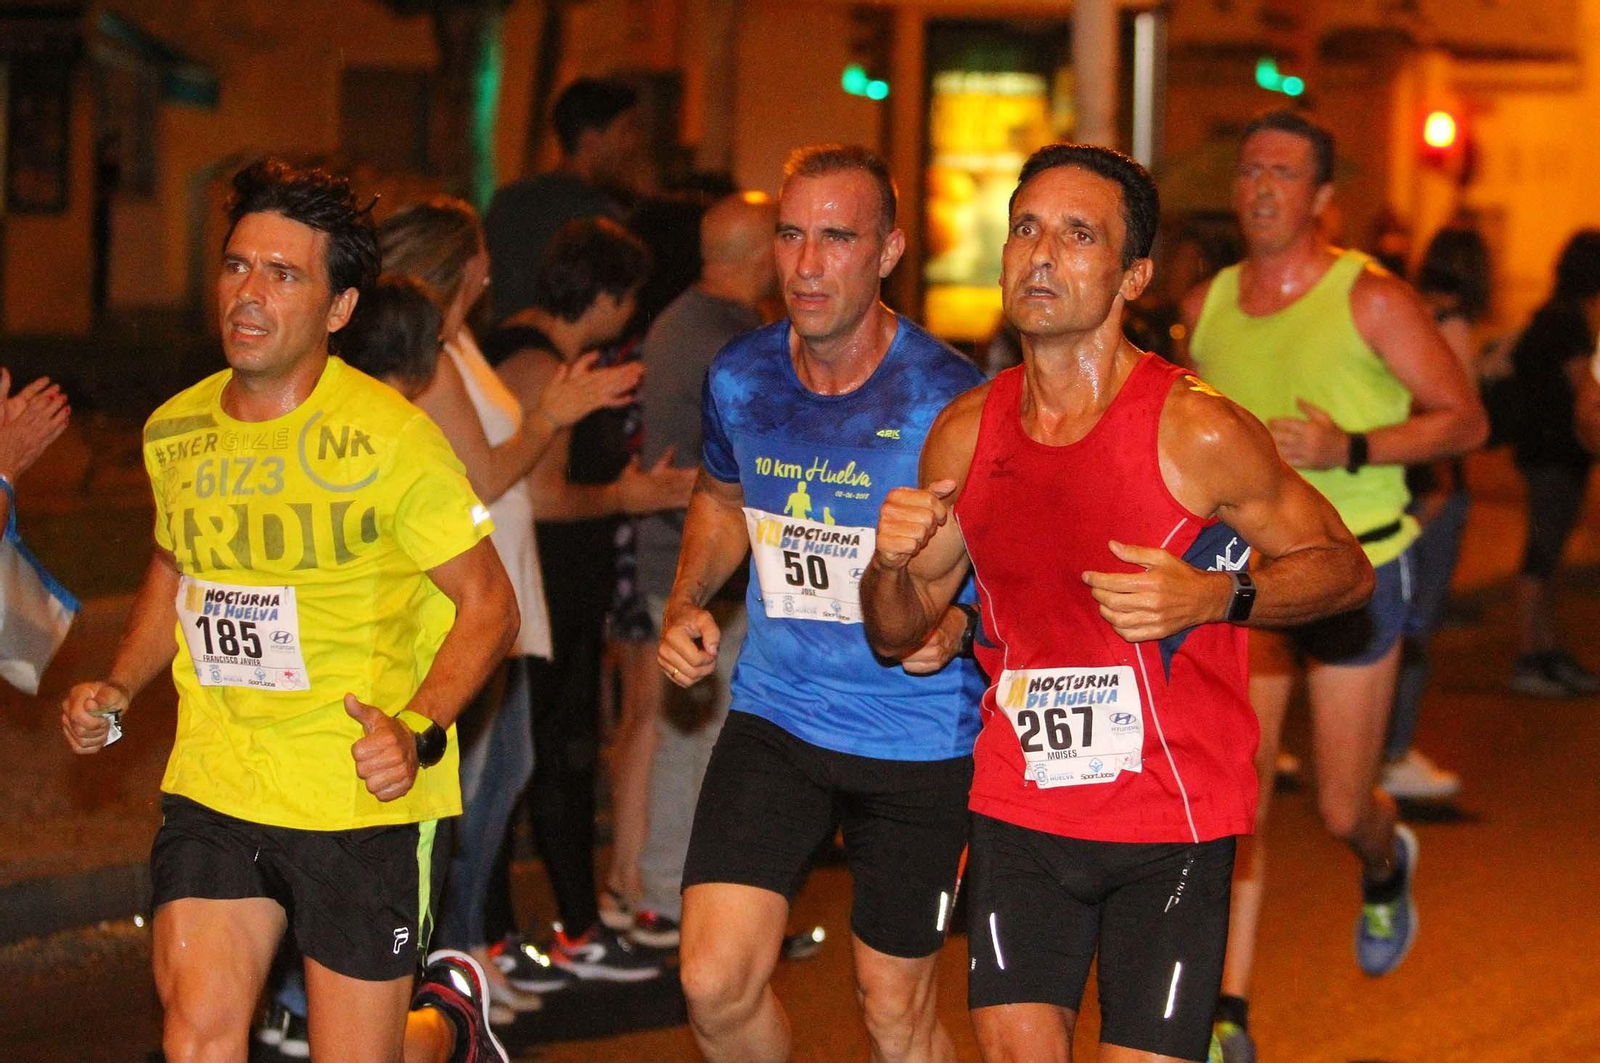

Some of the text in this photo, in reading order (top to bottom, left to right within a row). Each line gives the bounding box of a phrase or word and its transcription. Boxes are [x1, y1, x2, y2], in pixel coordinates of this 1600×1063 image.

[156, 427, 290, 466] #ENERGIZE
[755, 457, 872, 488] 10 km Huelva
[783, 524, 860, 546] NOCTURNA
[780, 536, 858, 559] DE HUELVA
[783, 550, 829, 590] 50
[205, 588, 280, 607] NOCTURNA
[203, 602, 278, 621] DE HUELVA
[195, 615, 263, 659] 185
[203, 655, 262, 668] FRANCISCO JAVIER
[1029, 674, 1119, 694] NOCTURNA
[1026, 689, 1118, 709] DE HUELVA
[1017, 706, 1093, 753] 267
[1047, 749, 1078, 760] MOISES
[1080, 771, 1115, 781] SportJobs
